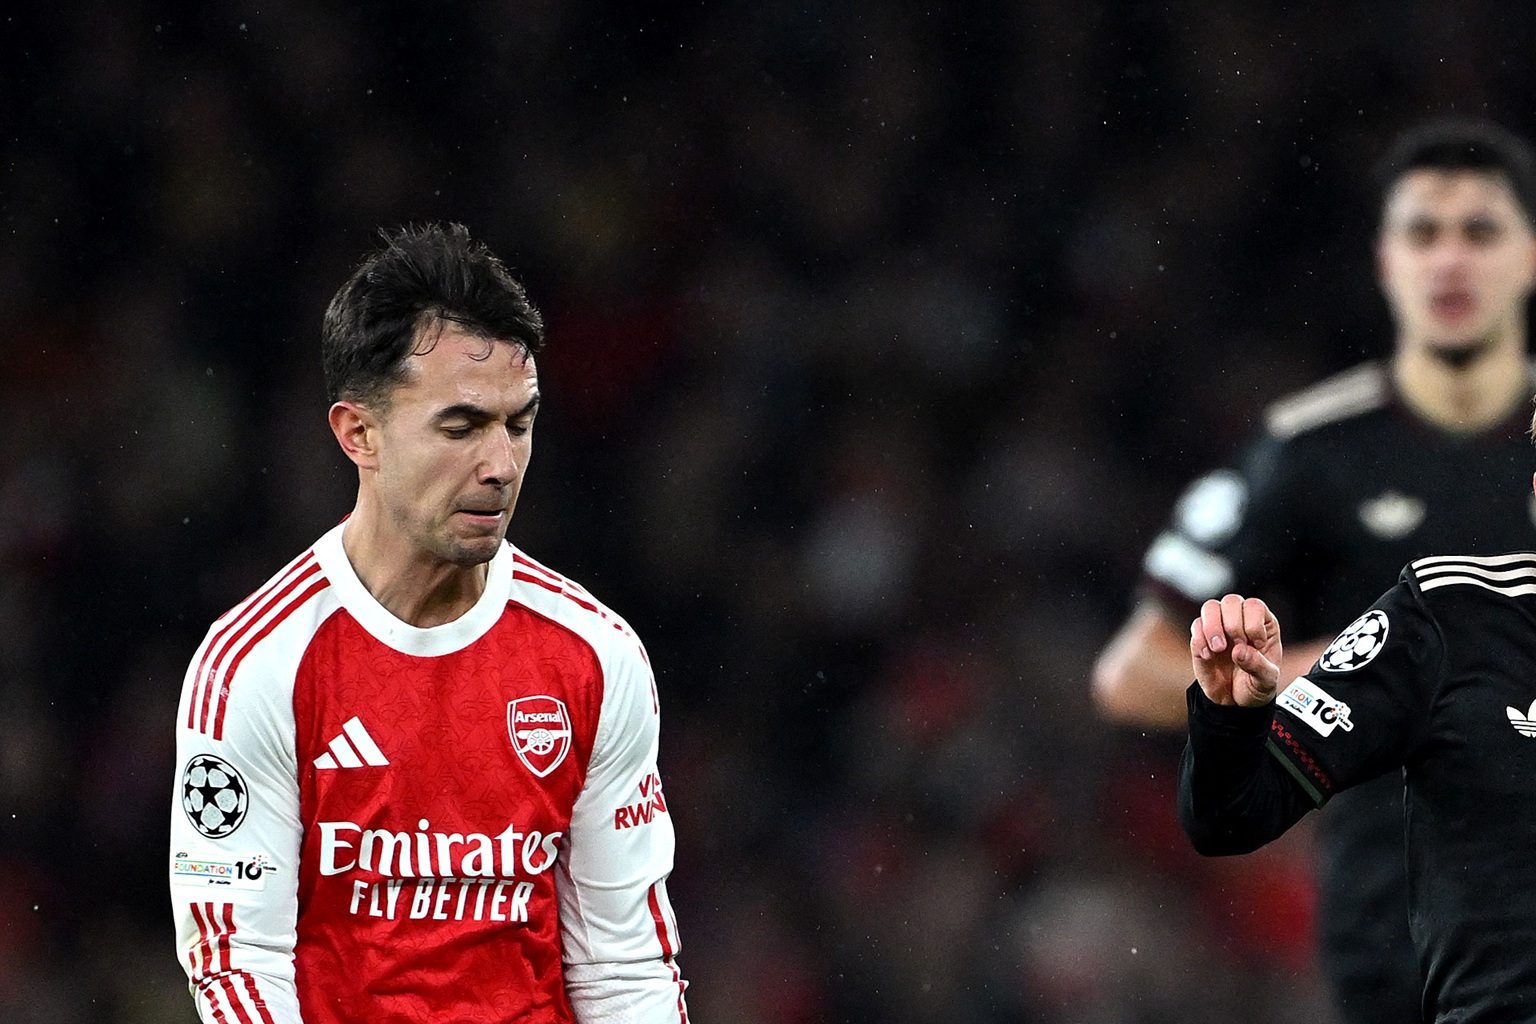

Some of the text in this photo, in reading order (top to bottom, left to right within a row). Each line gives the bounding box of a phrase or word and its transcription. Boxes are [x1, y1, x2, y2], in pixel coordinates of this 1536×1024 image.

[514, 710, 562, 723] Arsenal
[317, 818, 563, 877] Emirates
[234, 861, 262, 881] 10
[349, 877, 535, 923] FLY BETTER
